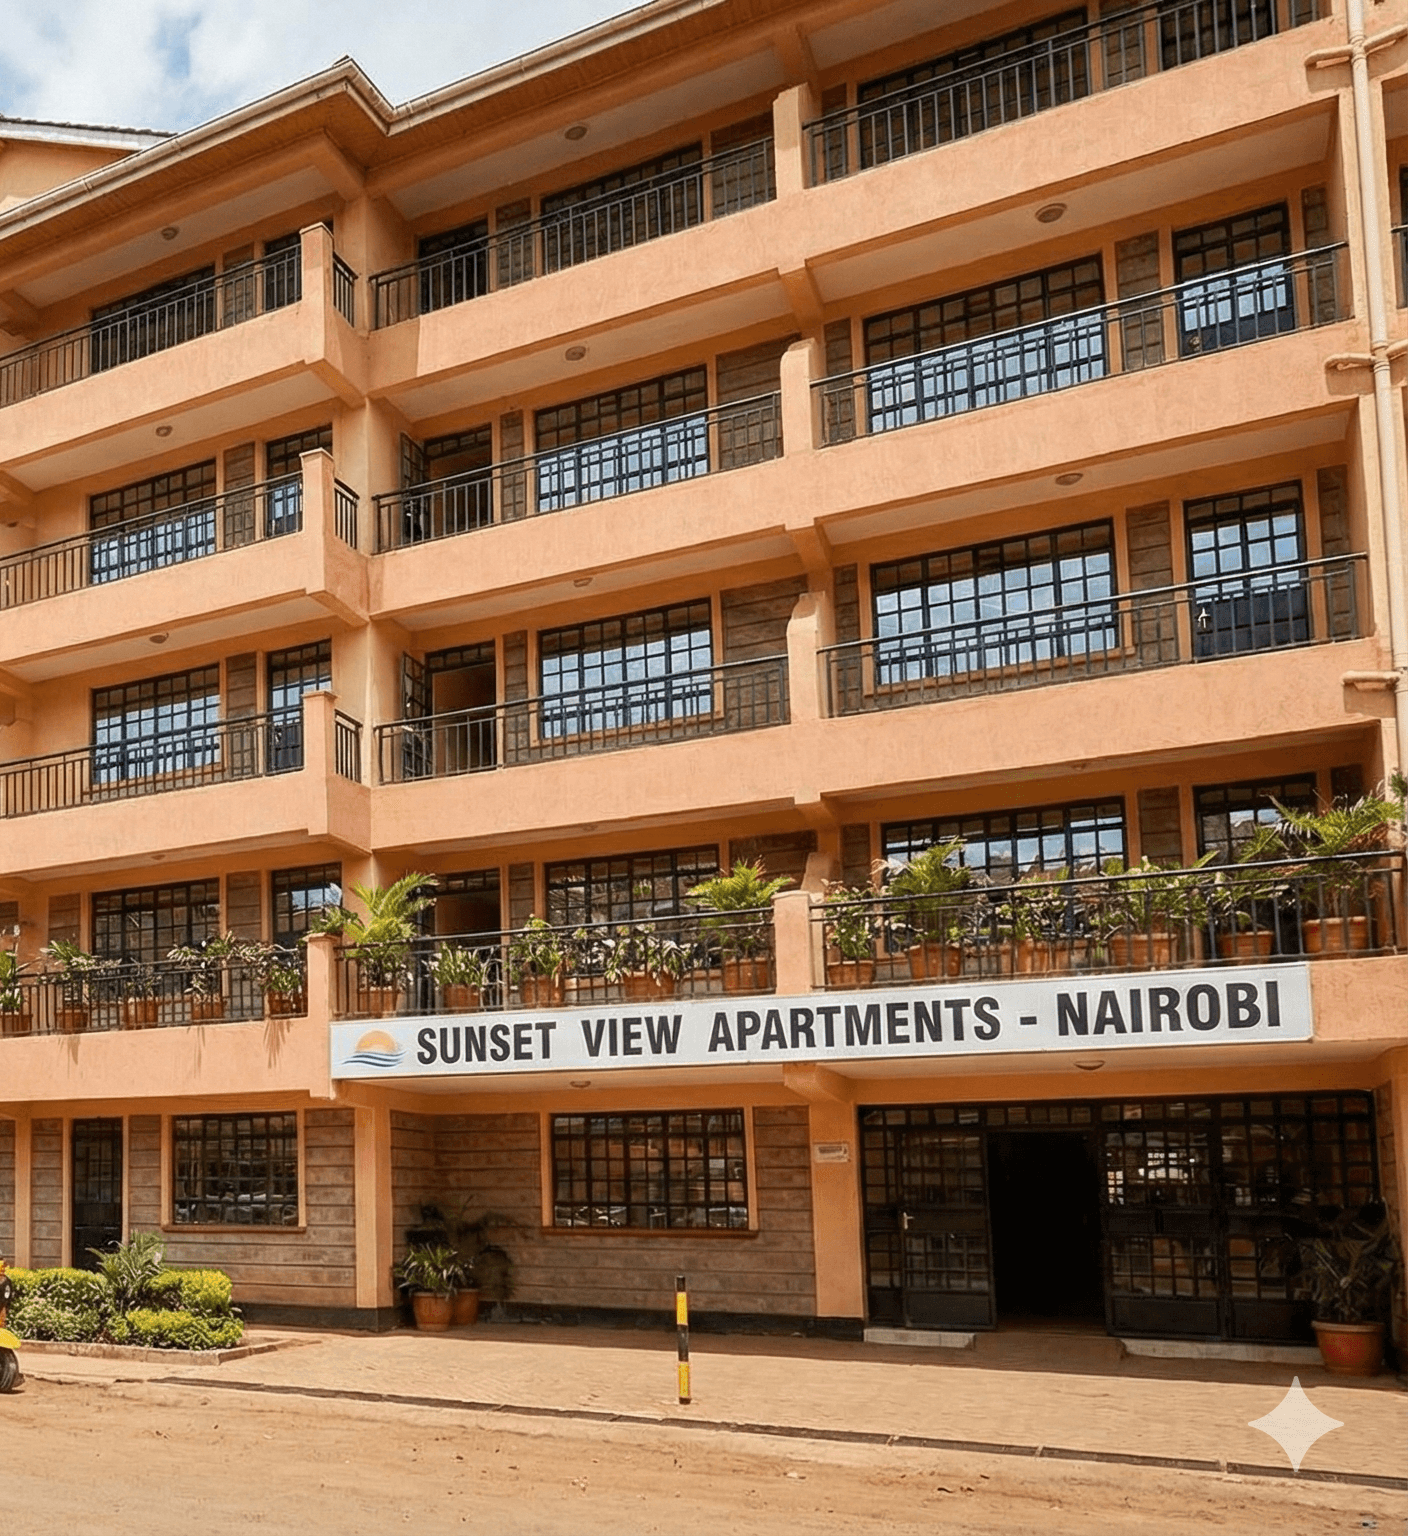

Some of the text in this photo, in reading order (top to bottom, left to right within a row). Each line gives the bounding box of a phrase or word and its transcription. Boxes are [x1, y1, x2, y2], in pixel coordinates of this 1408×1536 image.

[417, 980, 1281, 1065] SUNSET VIEW APARTMENTS - NAIROBI
